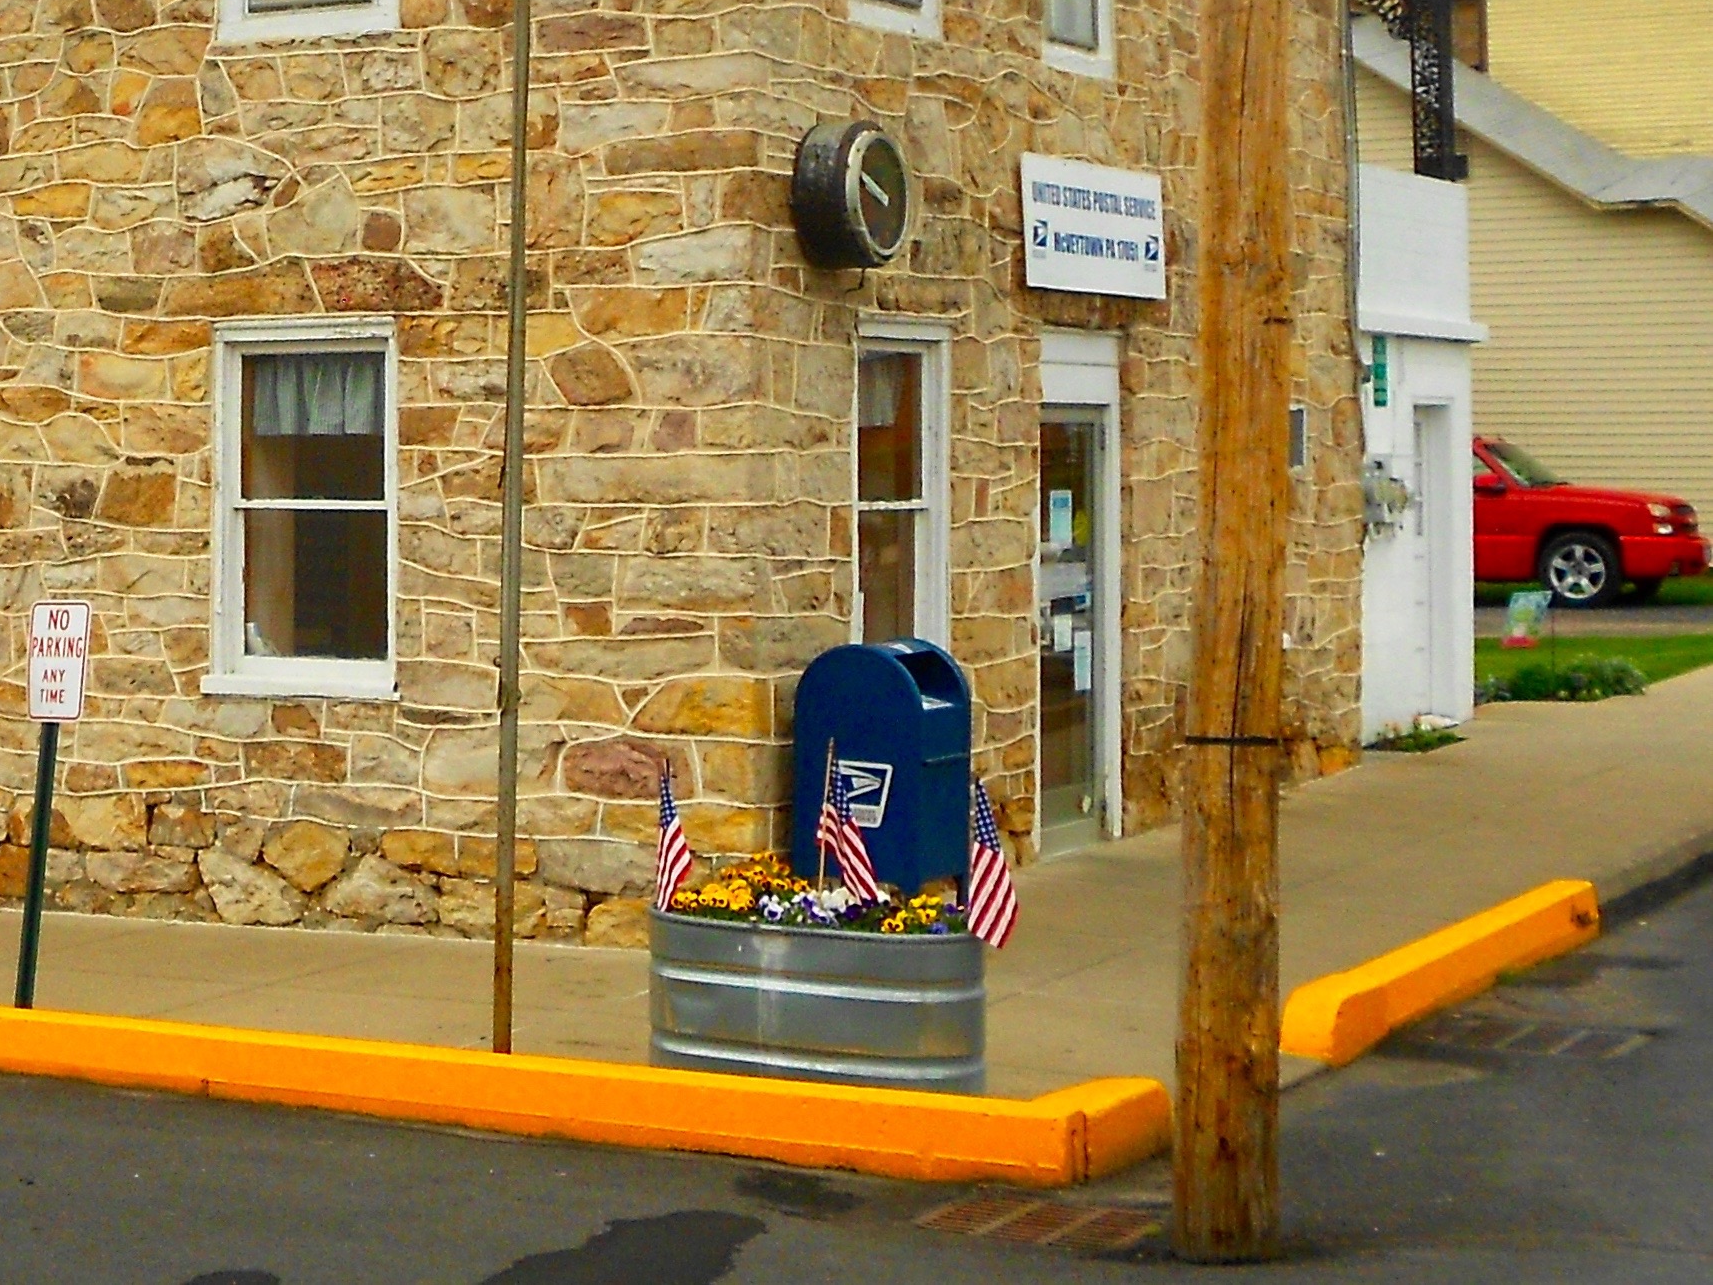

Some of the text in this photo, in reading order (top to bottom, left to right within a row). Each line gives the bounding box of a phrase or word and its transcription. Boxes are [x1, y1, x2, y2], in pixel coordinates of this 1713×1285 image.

[1032, 181, 1156, 220] UNITED STATES POSTAL SERVICE
[1106, 238, 1116, 259] PA
[48, 609, 70, 631] NO
[32, 637, 83, 658] PARKING
[42, 669, 66, 683] ANY
[40, 689, 65, 704] TIME
